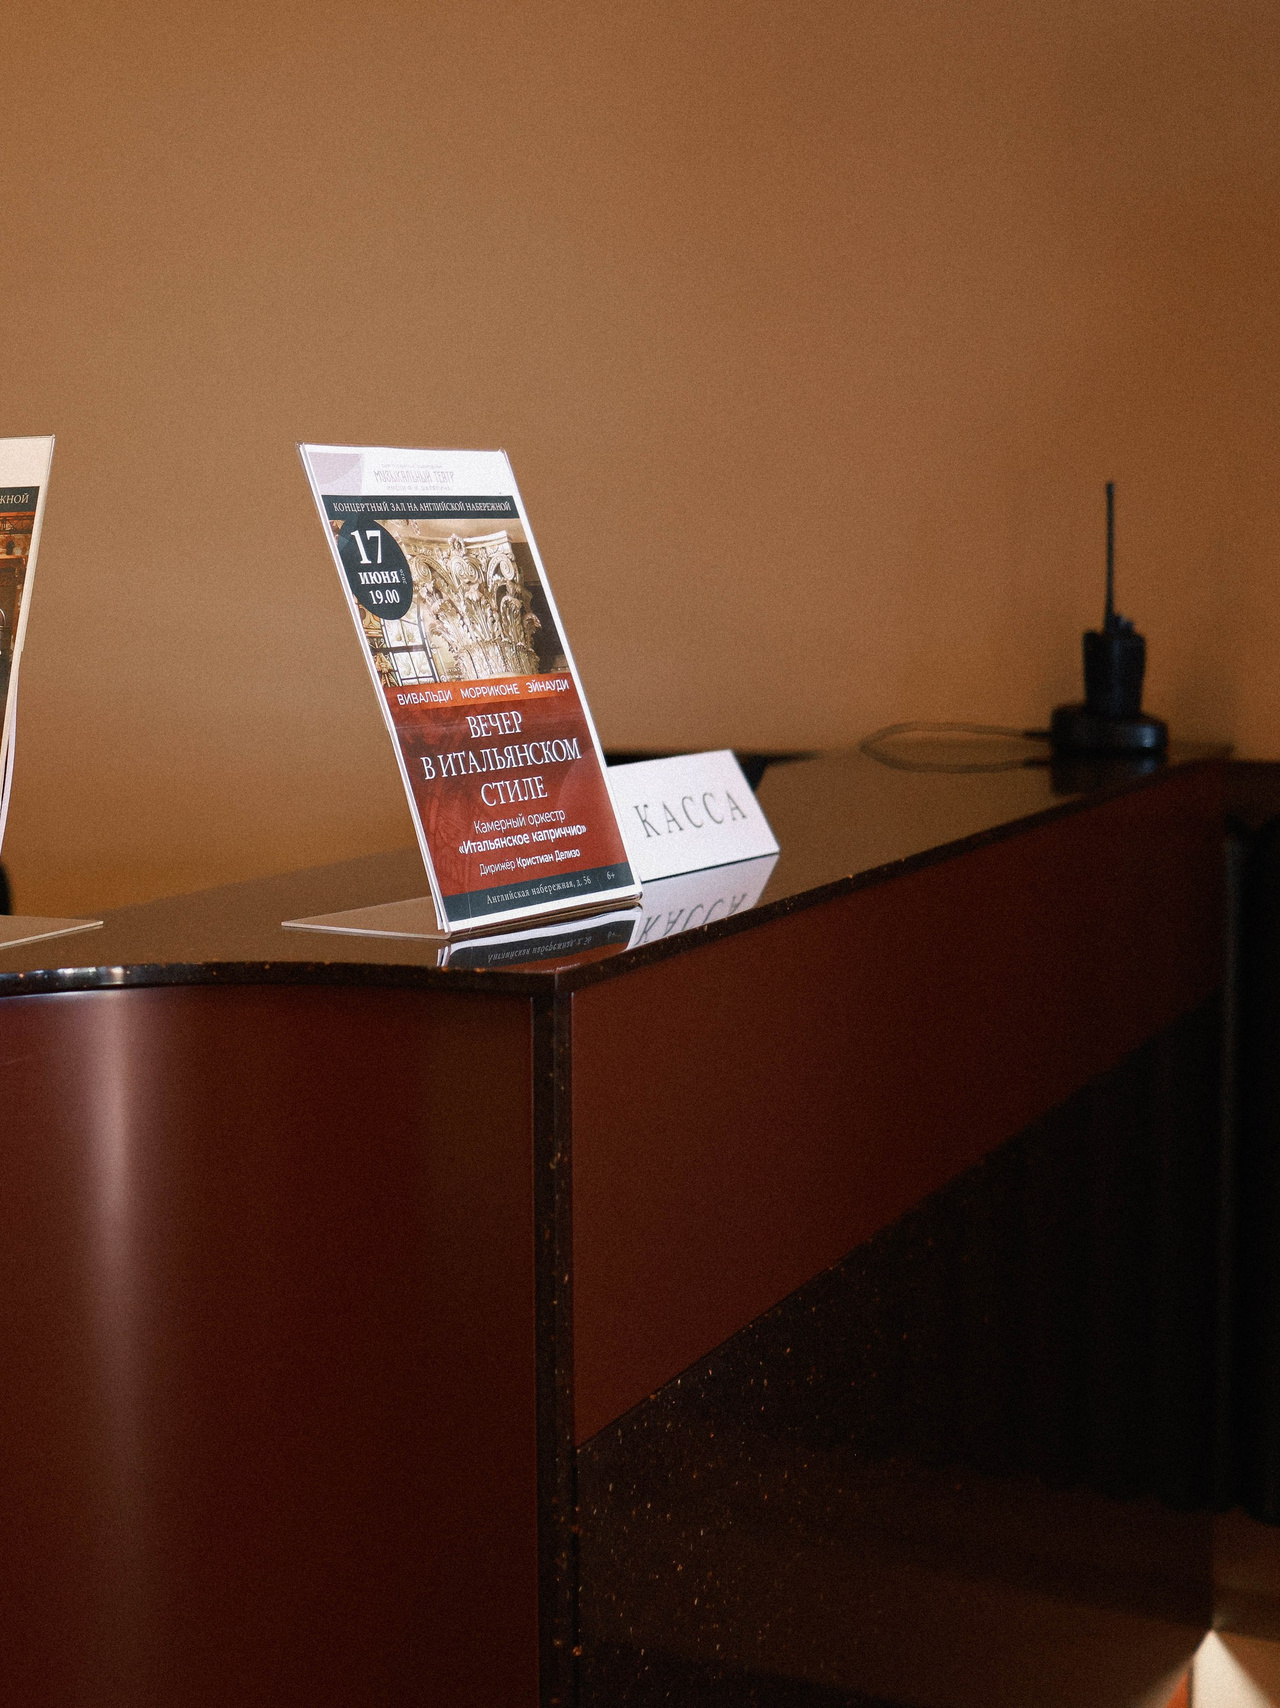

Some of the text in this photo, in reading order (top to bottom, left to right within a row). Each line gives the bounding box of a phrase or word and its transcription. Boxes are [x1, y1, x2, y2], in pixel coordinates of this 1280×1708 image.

[433, 470, 454, 483] ТЕАТР
[332, 501, 512, 513] КОНЦЕРТНЫЙ ЗАЛ НА АНГЛИЙСКОЙ НАБЕРЕЖНОЙ
[350, 530, 382, 564] 17
[358, 570, 401, 585] июня
[369, 589, 400, 604] 19.00
[396, 678, 570, 706] ВИВАЛЬДИ МОРРИКОНЕ ЭЙНАУДИ
[465, 710, 523, 739] ВЕЧЕР
[420, 737, 583, 780] В ИТАЛЬЯНСКОМ
[480, 775, 549, 807] СТИЛЕ
[473, 809, 566, 835] Камерный оркестр
[633, 790, 747, 838] КАССА
[458, 824, 587, 855] «Итальянское каприччио»
[479, 848, 581, 877] Дирижёр Кристиан Делизо
[606, 870, 616, 881] 6+
[486, 875, 592, 905] Английская набережная, д. 56
